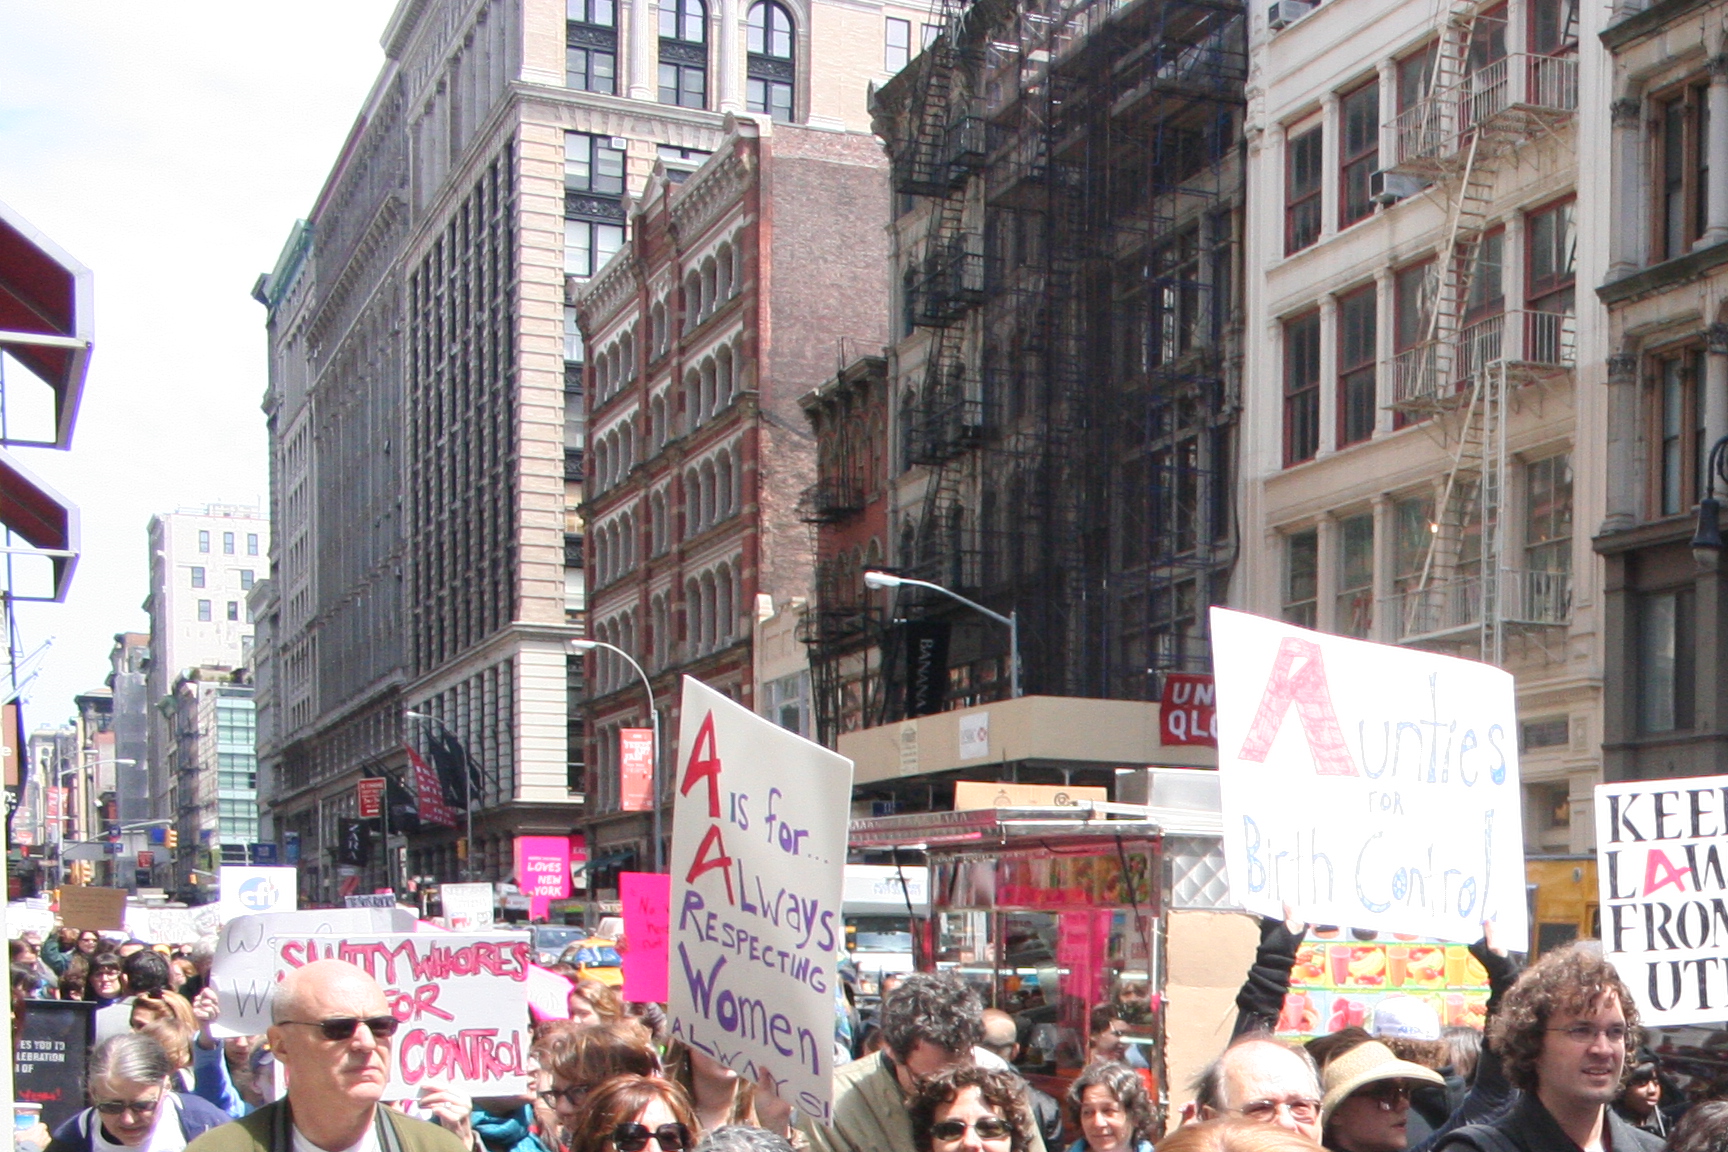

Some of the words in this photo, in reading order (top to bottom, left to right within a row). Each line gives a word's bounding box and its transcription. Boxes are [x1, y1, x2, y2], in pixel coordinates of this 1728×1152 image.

[1238, 637, 1506, 787] Aunties
[681, 709, 721, 818] A
[1369, 791, 1404, 815] FOR
[527, 861, 562, 873] LOVES
[534, 886, 562, 897] YORK
[538, 875, 562, 885] NEW
[1243, 814, 1334, 906] Birth
[1355, 809, 1497, 926] Control
[405, 940, 531, 983] WHORES
[678, 889, 827, 993] RESPECTING
[677, 940, 819, 1076] Women
[400, 1028, 528, 1085] CONTROL
